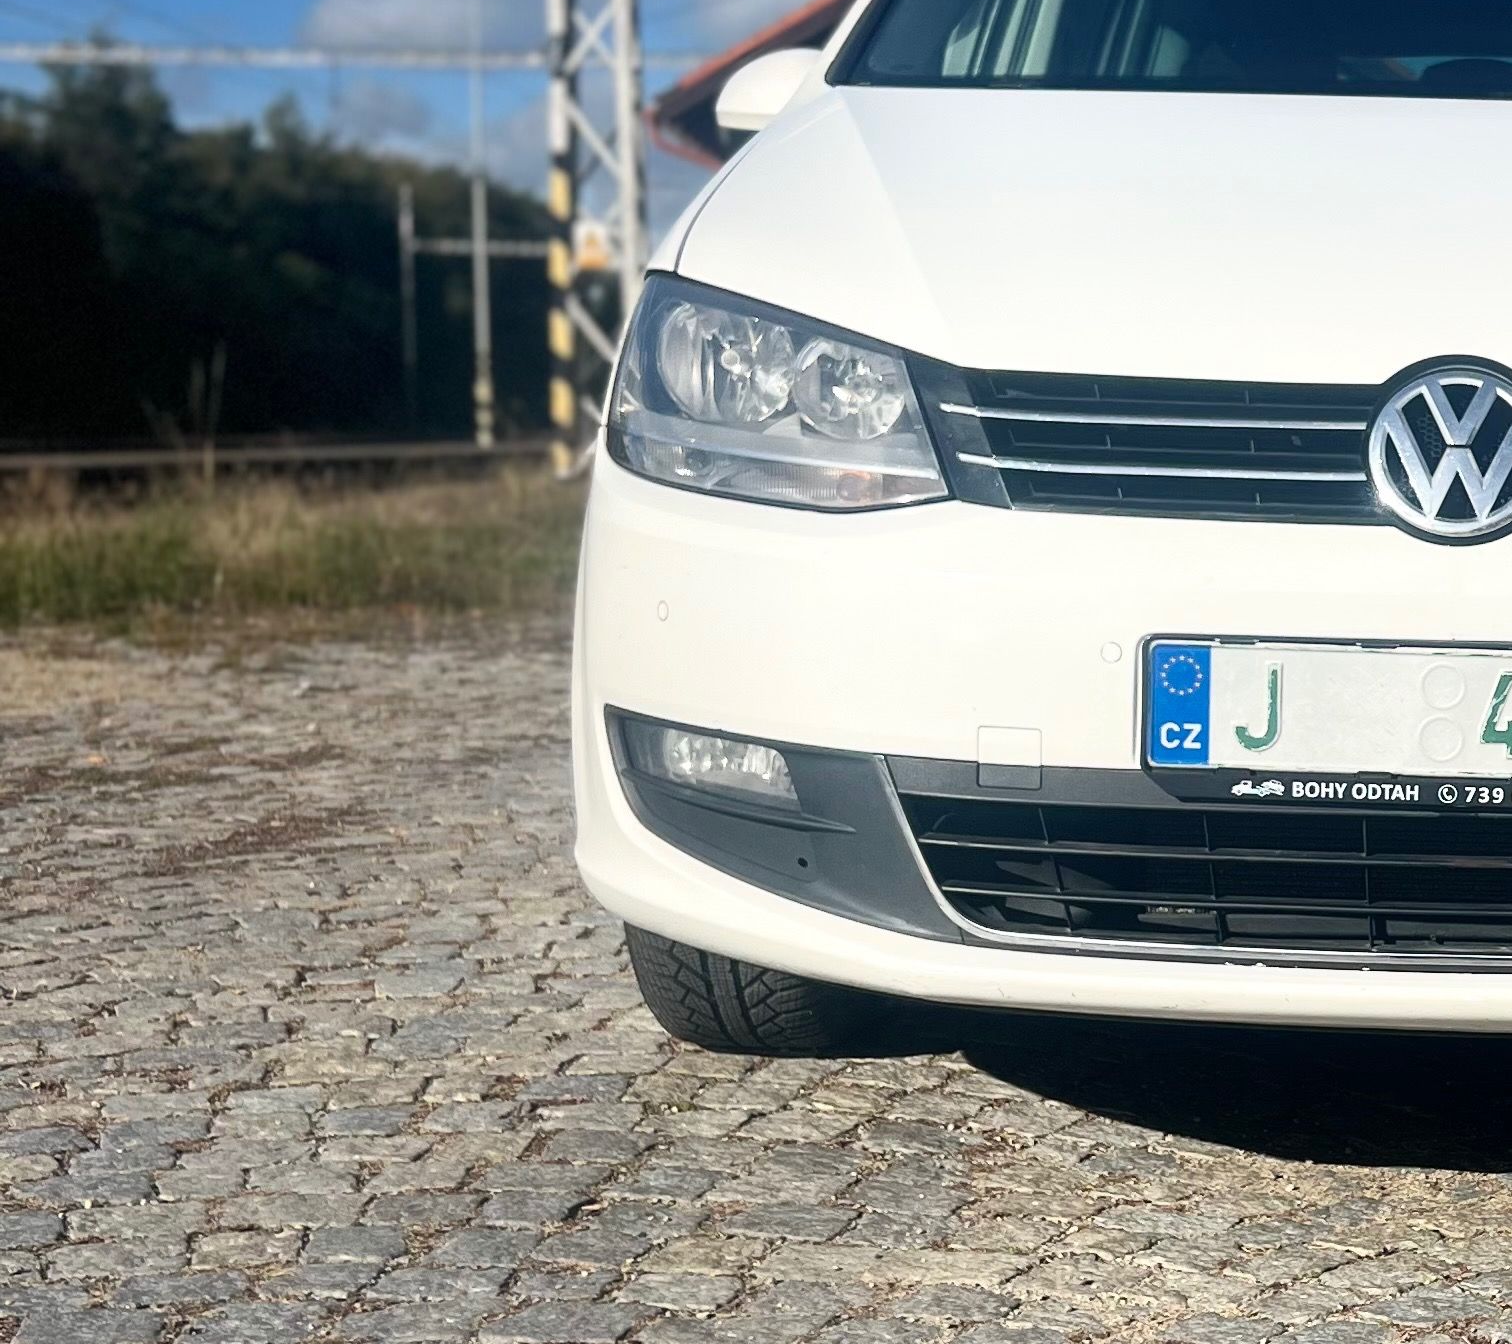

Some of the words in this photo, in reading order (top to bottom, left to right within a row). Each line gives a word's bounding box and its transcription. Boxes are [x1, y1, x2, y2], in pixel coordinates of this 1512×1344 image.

[1234, 662, 1283, 752] J
[1159, 721, 1203, 750] CZ
[1292, 781, 1348, 799] BOHY
[1351, 783, 1420, 801] ODTAH
[1464, 786, 1505, 803] 739
